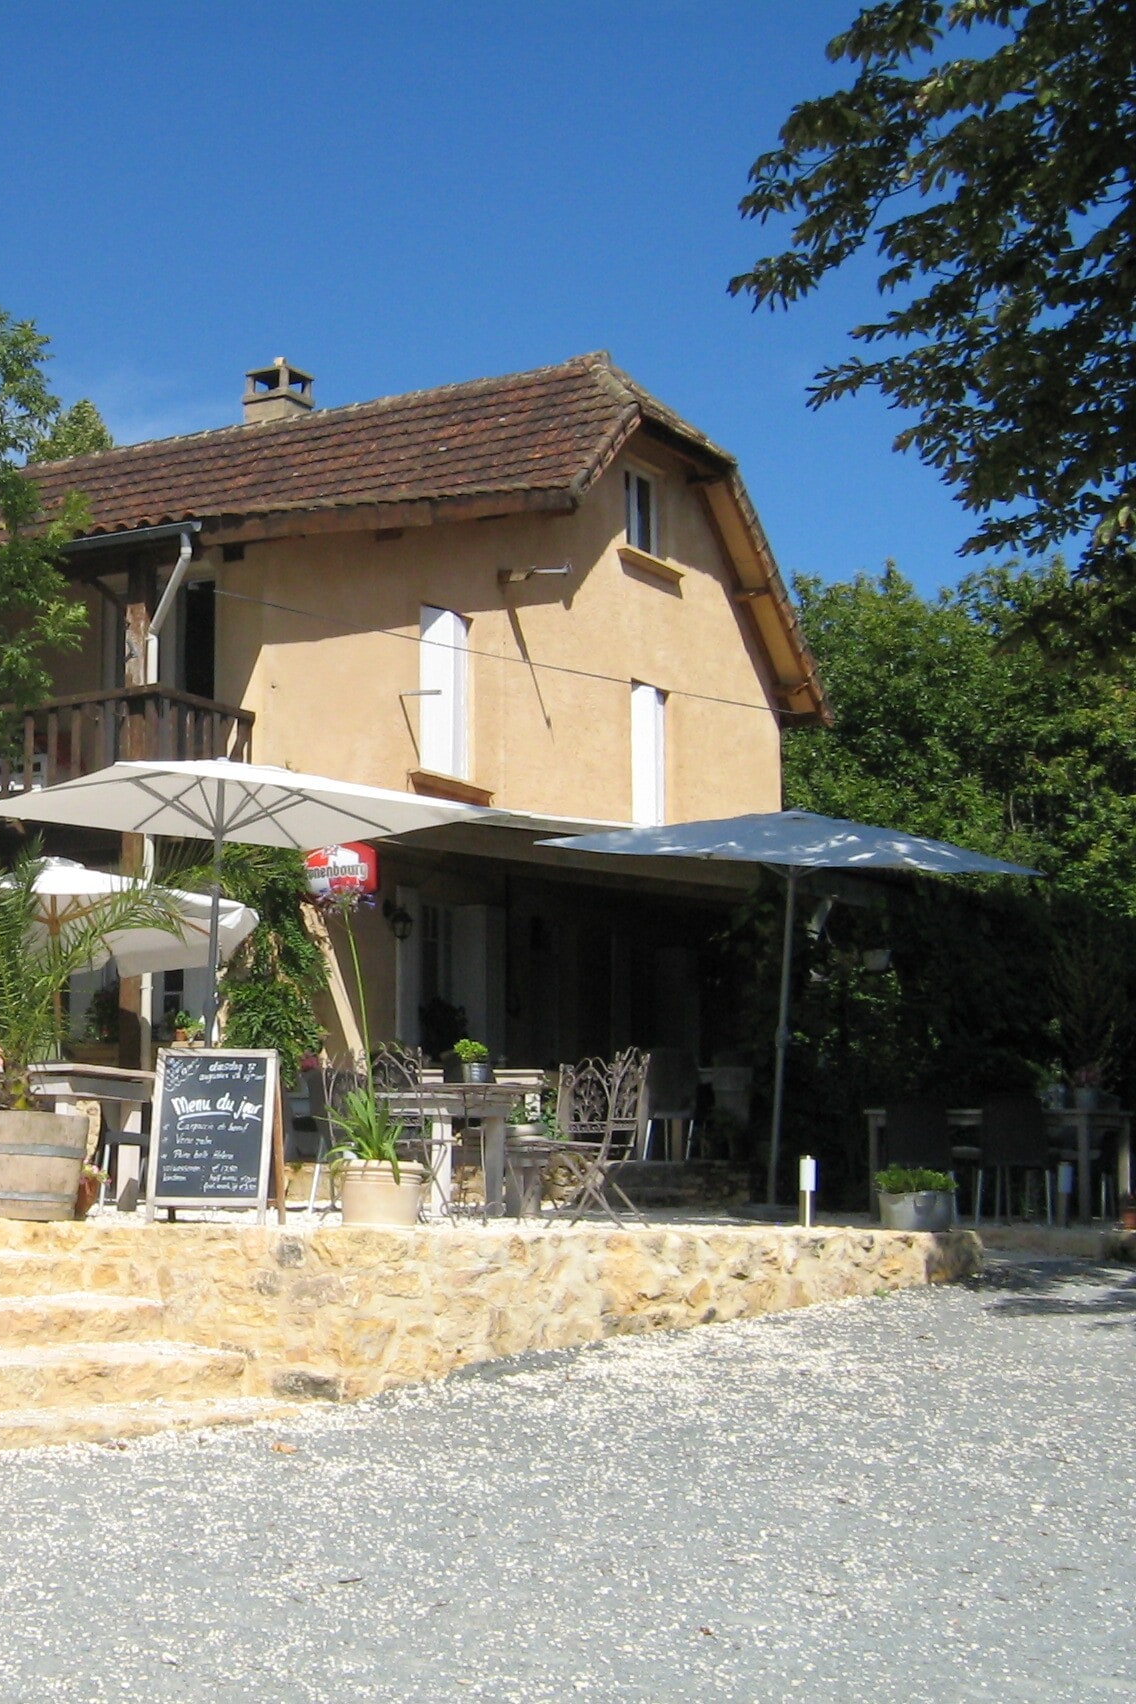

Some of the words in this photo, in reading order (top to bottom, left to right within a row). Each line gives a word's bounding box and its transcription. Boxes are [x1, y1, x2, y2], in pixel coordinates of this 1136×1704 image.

[308, 861, 367, 880] nenbourg
[171, 1096, 211, 1115] Menu
[216, 1092, 235, 1111] du
[233, 1096, 262, 1119] jour
